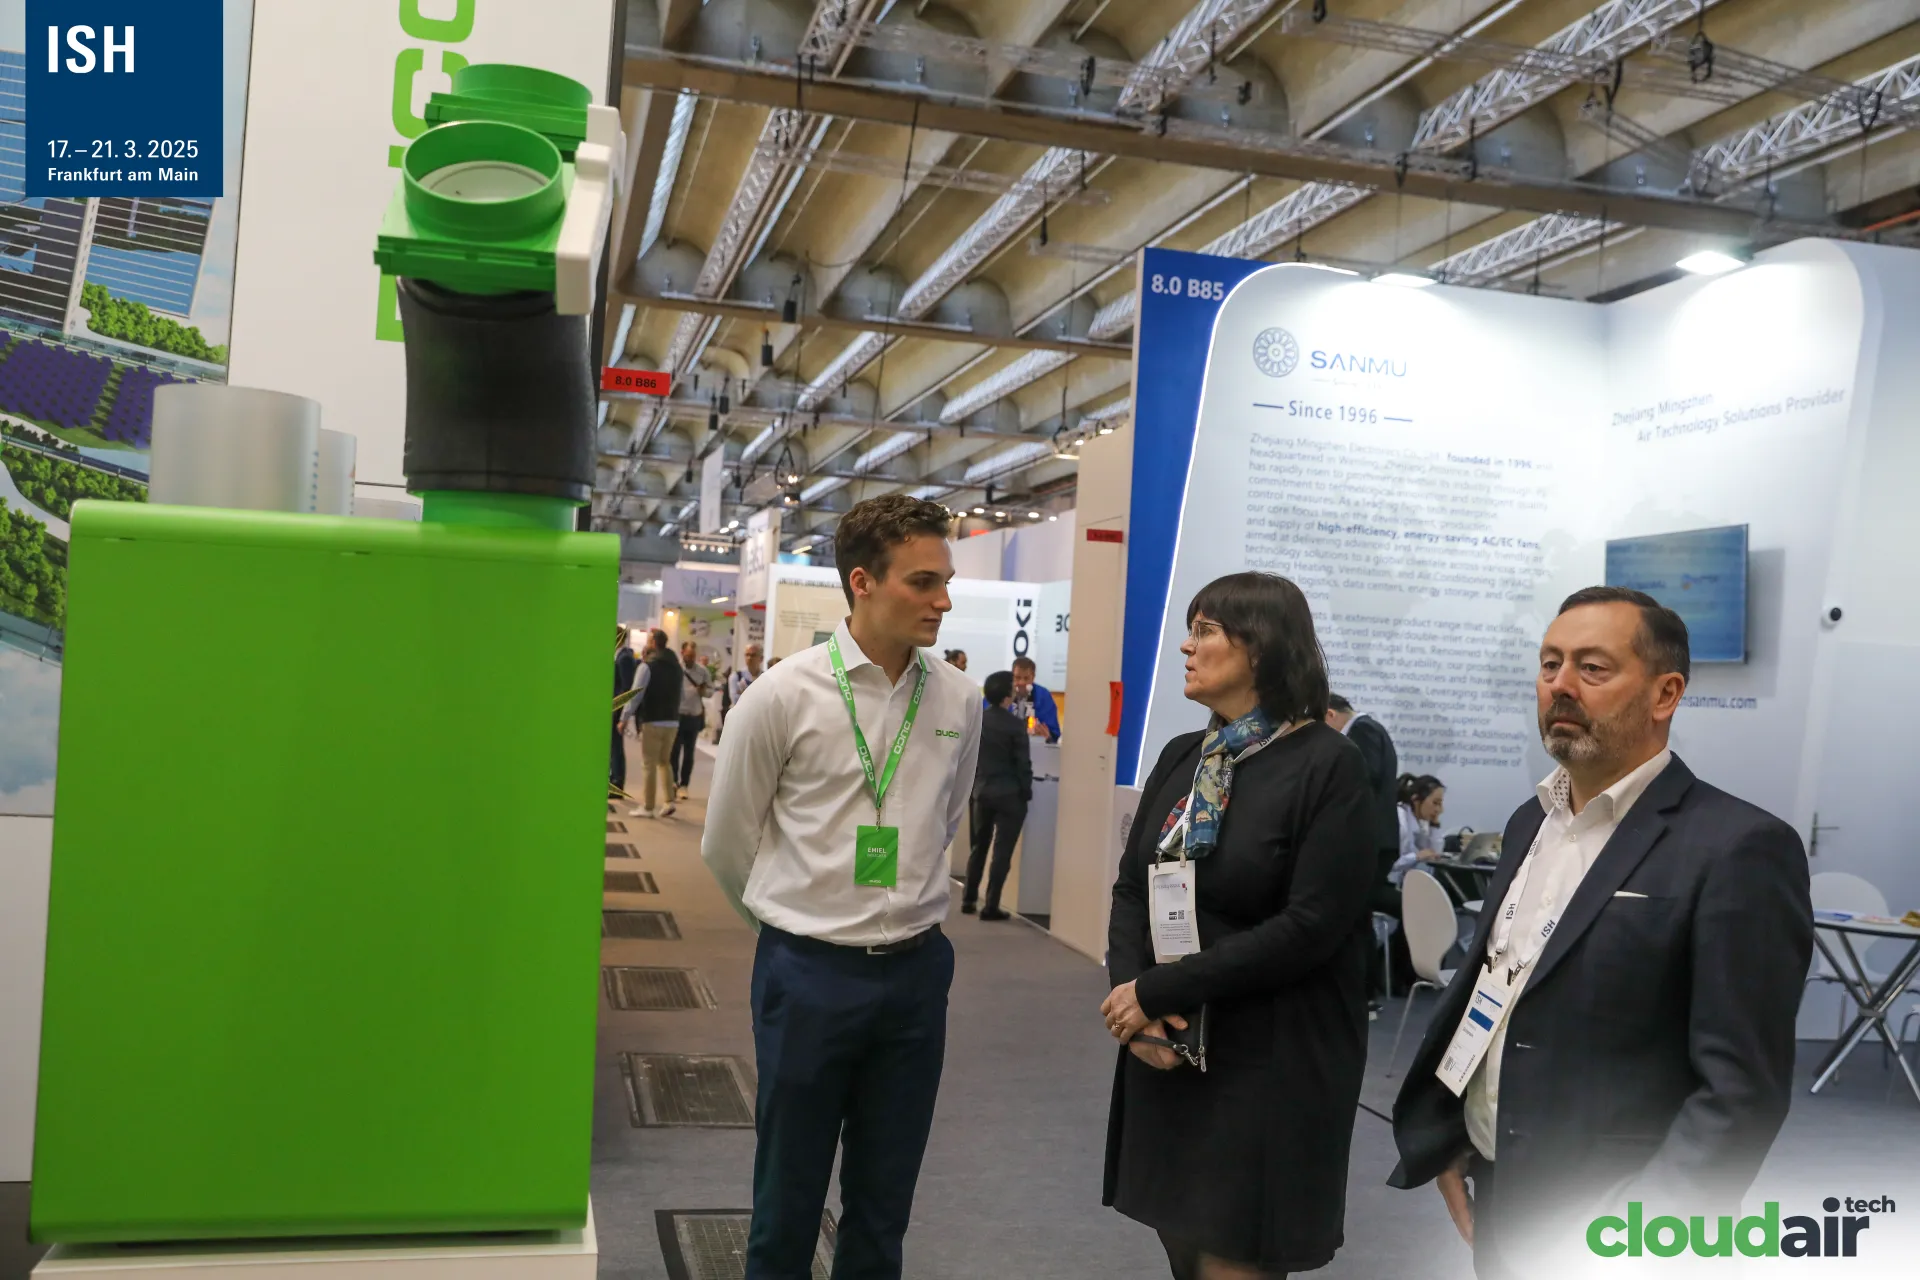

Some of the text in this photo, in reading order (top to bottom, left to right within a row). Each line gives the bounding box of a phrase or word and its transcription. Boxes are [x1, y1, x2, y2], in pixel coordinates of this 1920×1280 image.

[1151, 273, 1224, 301] 8.0 B85
[1310, 350, 1407, 378] SANMU
[615, 376, 657, 388] 8.0 B86
[1288, 400, 1378, 424] Since 1996
[1612, 406, 1655, 426] Zhejiang
[1637, 388, 1846, 443] Air Technology Solutions Provider
[1249, 446, 1323, 464] headquartered
[1447, 452, 1490, 465] founded
[1248, 460, 1265, 470] has
[1269, 462, 1302, 476] rapidly
[1306, 466, 1329, 476] risen
[1247, 474, 1312, 488] commitment
[1247, 488, 1283, 499] control
[1246, 503, 1263, 511] our
[1266, 505, 1288, 513] core
[1292, 505, 1319, 516] focus
[1352, 511, 1367, 520] the
[1246, 515, 1265, 525] and
[1267, 517, 1300, 531] supply
[1316, 521, 1400, 539] high-efficiency,
[1245, 529, 1276, 540] aimed
[1292, 533, 1341, 548] delivering
[1244, 542, 1301, 558] technology
[1303, 547, 1348, 559] solutions
[1372, 553, 1403, 566] global
[1342, 578, 1364, 588] data
[1407, 585, 1440, 596] energy
[1484, 589, 1501, 598] and
[1344, 612, 1389, 624] extensive
[1392, 616, 1431, 629] product
[1433, 621, 1460, 631] range
[1376, 655, 1394, 665] and
[836, 667, 852, 701] DUCO
[1347, 669, 1396, 678] numerous
[1400, 670, 1446, 682] industries
[1448, 674, 1466, 683] and
[1469, 675, 1491, 685] have
[913, 671, 927, 705] DUCO
[1398, 713, 1429, 721] ensure
[1432, 713, 1448, 722] the
[1452, 714, 1491, 727] superior
[893, 720, 912, 755] DUCO
[935, 729, 960, 739] DUCO
[1399, 726, 1425, 736] every
[1500, 743, 1521, 753] such
[859, 745, 875, 782] DUCO
[1435, 753, 1457, 762] solid
[1458, 754, 1508, 767] guarantee
[1505, 903, 1516, 920] ISH
[1540, 919, 1556, 938] ISH
